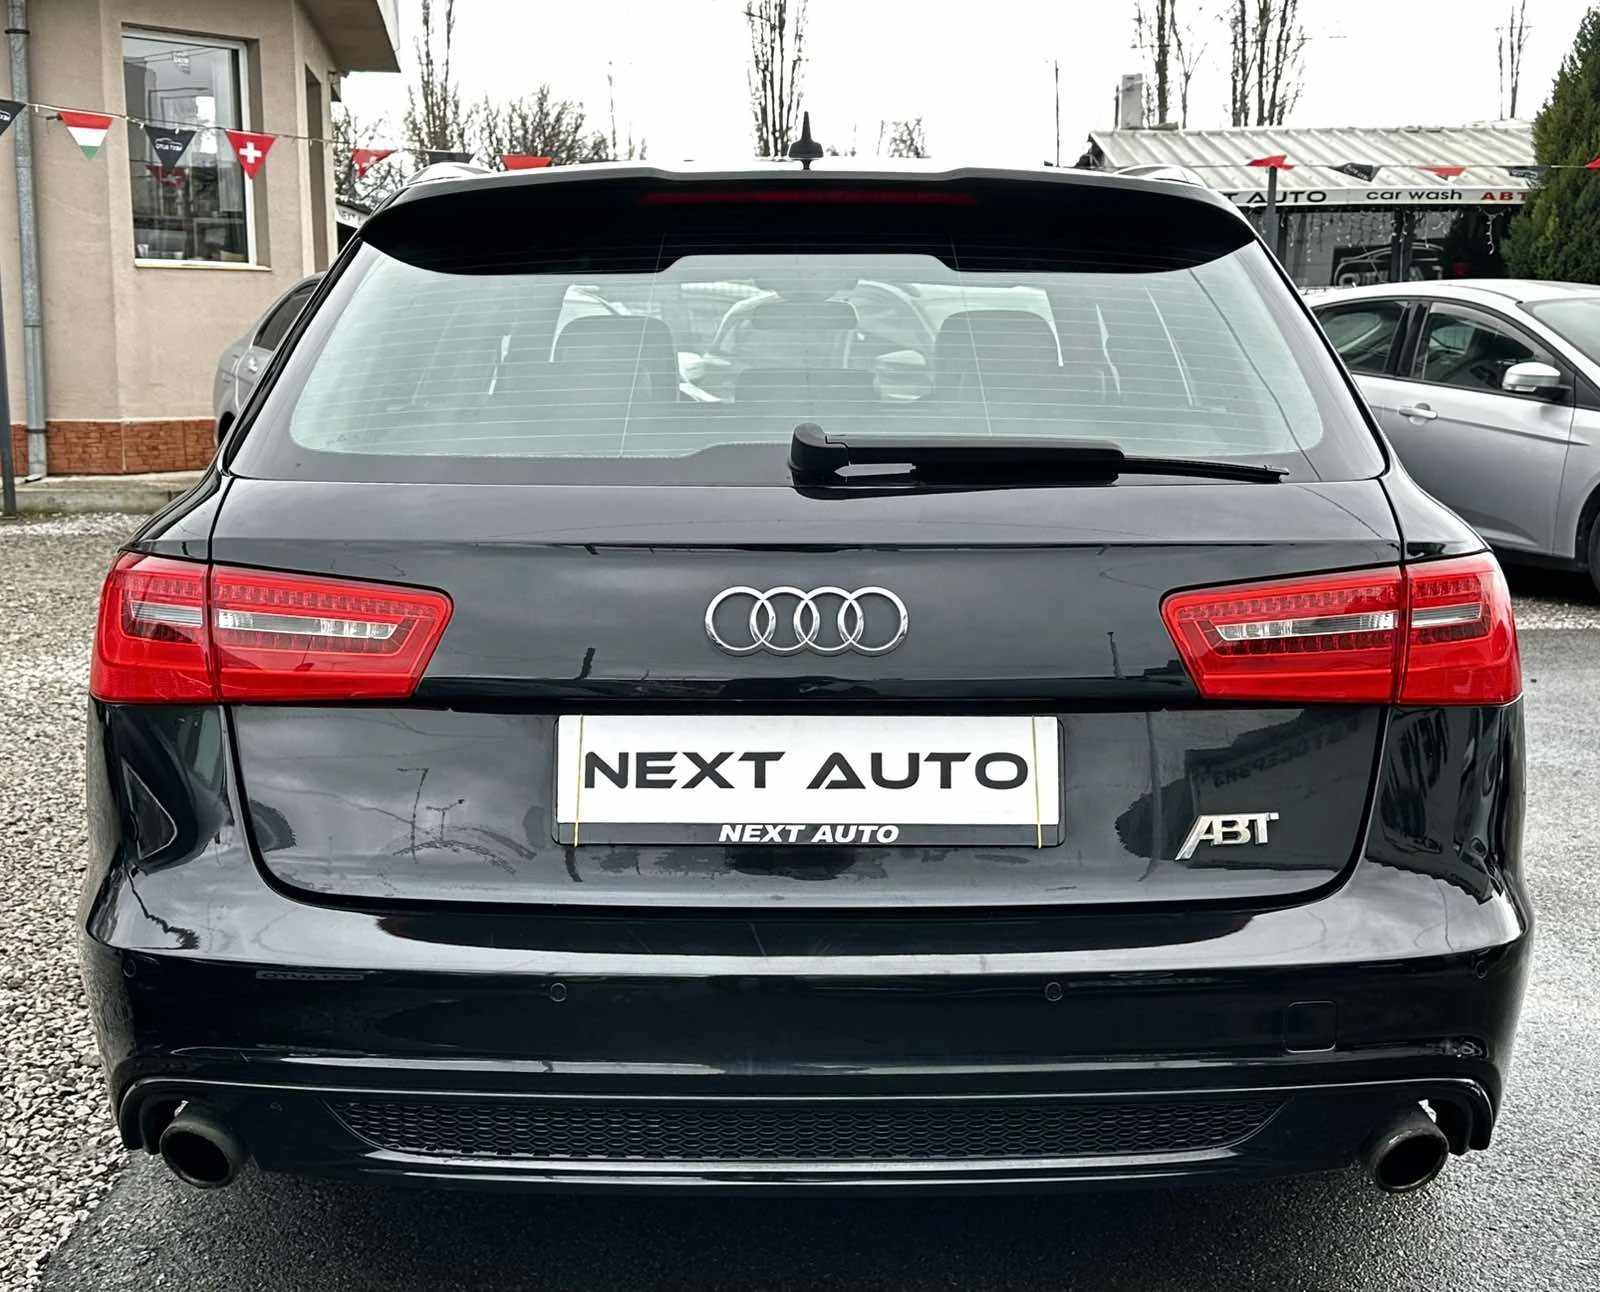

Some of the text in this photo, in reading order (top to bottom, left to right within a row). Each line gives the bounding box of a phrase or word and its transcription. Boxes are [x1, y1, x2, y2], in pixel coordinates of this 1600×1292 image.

[1366, 191, 1401, 200] car
[1408, 189, 1462, 200] wash
[584, 751, 1029, 790] NEXT AUTO
[718, 824, 900, 844] NEXT AUTO
[1175, 812, 1280, 860] ABT
